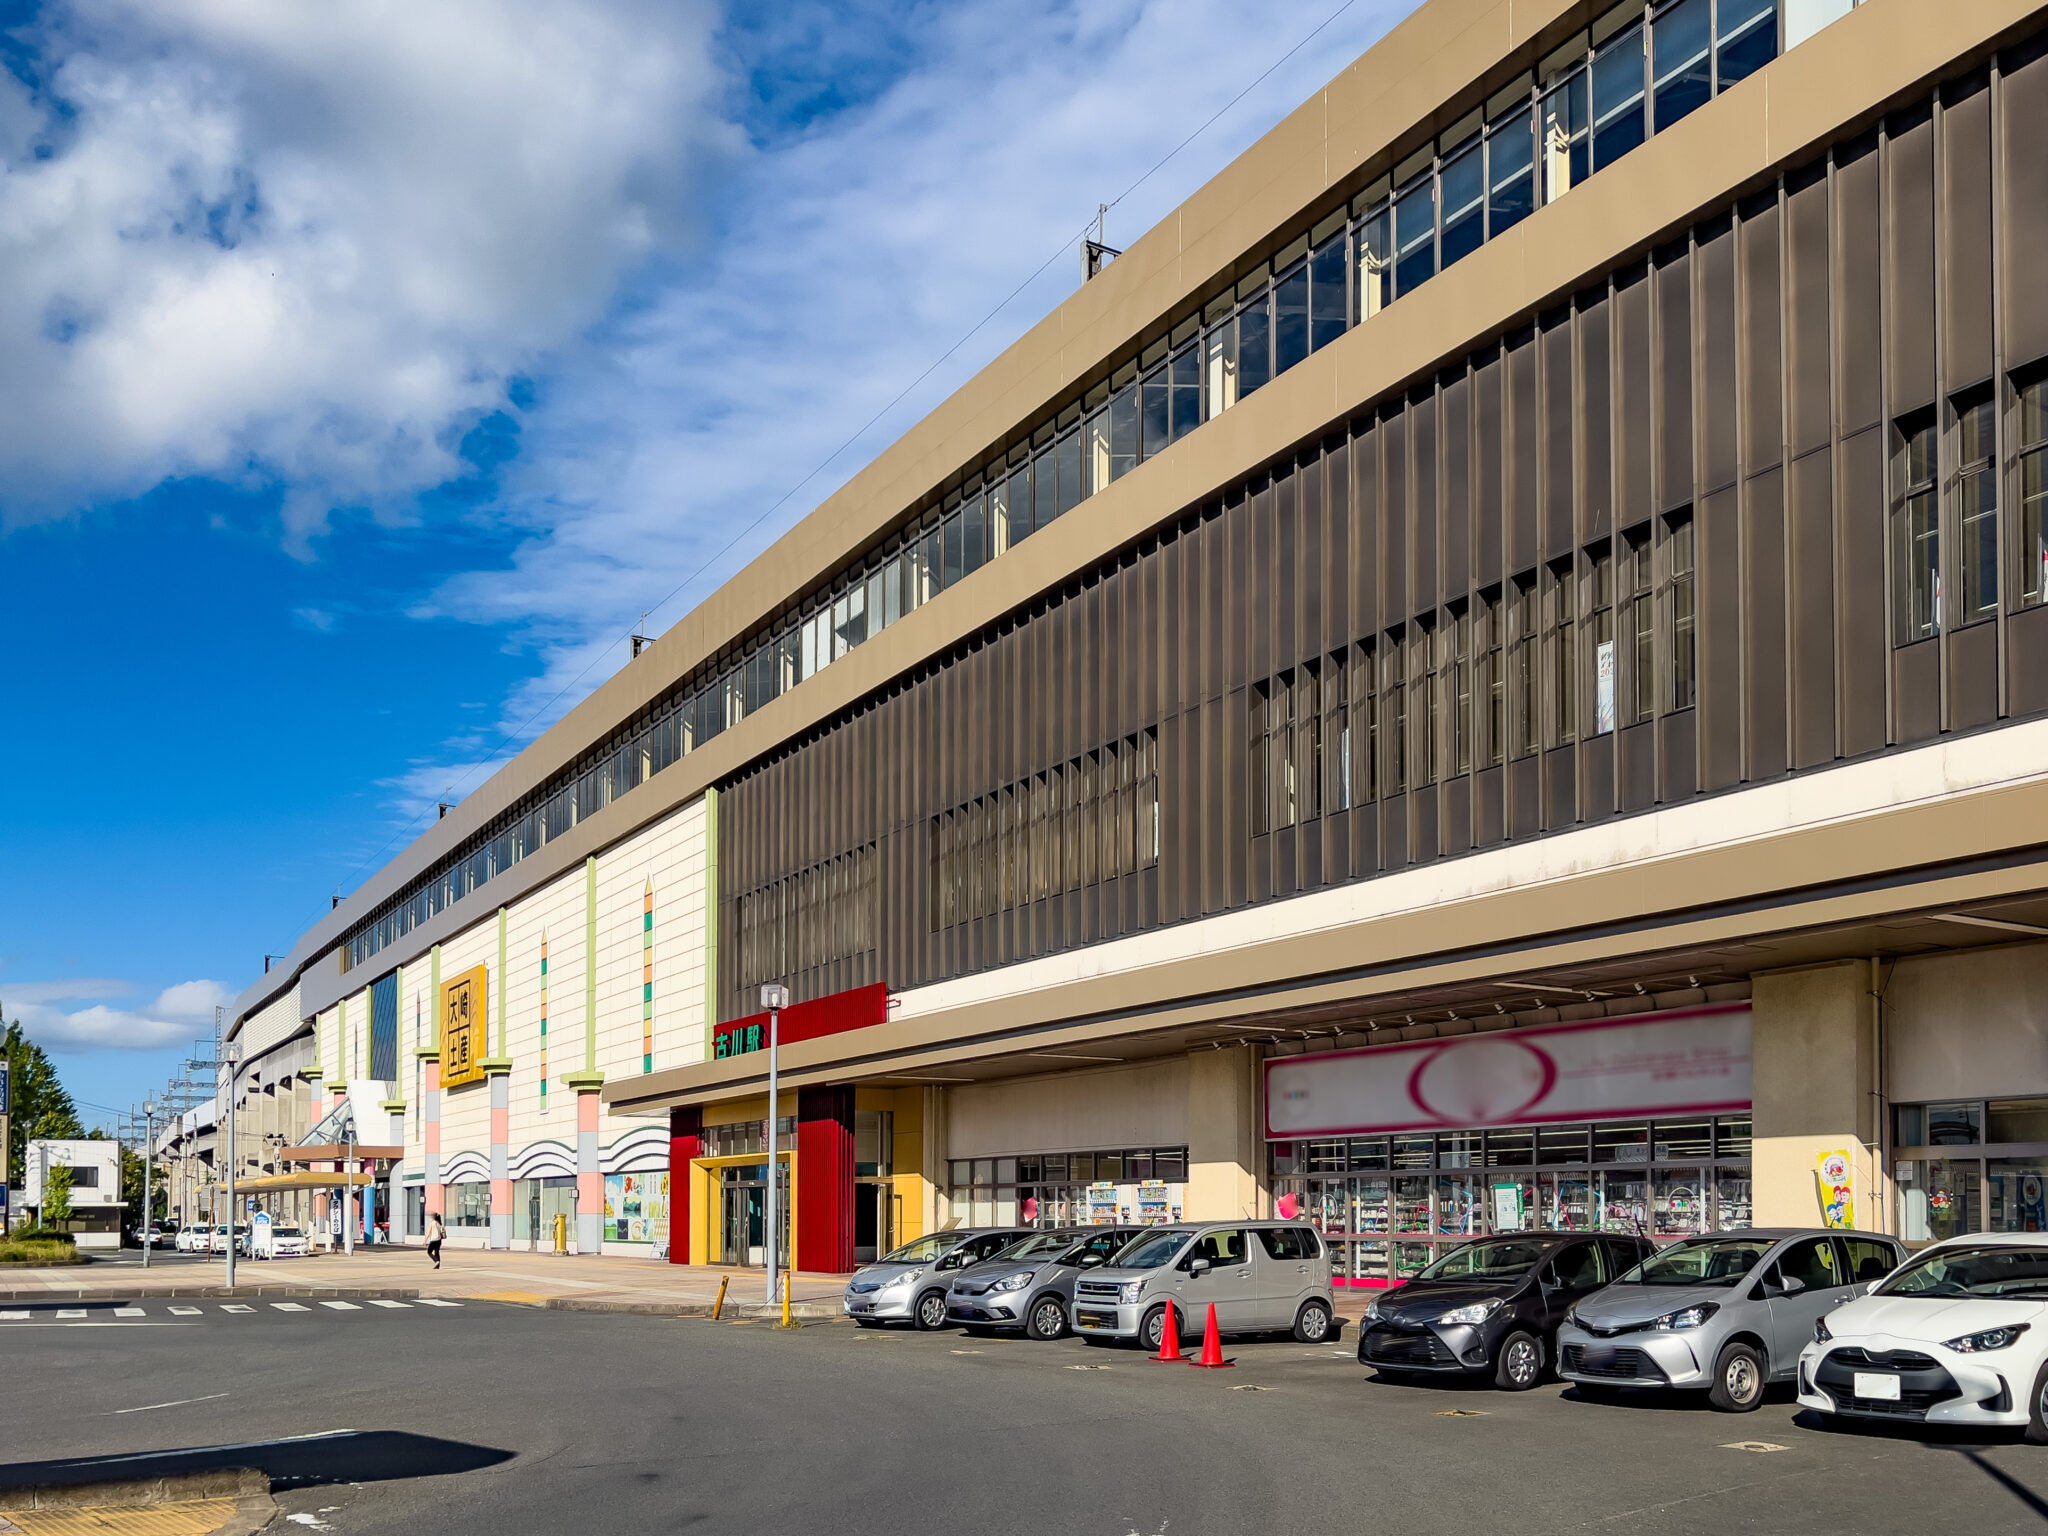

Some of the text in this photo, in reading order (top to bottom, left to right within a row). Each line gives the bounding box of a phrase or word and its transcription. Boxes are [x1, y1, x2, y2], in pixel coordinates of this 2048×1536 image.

[450, 989, 468, 1025] 大崎
[450, 1035, 468, 1067] 土産
[716, 1024, 760, 1060] 古川駅
